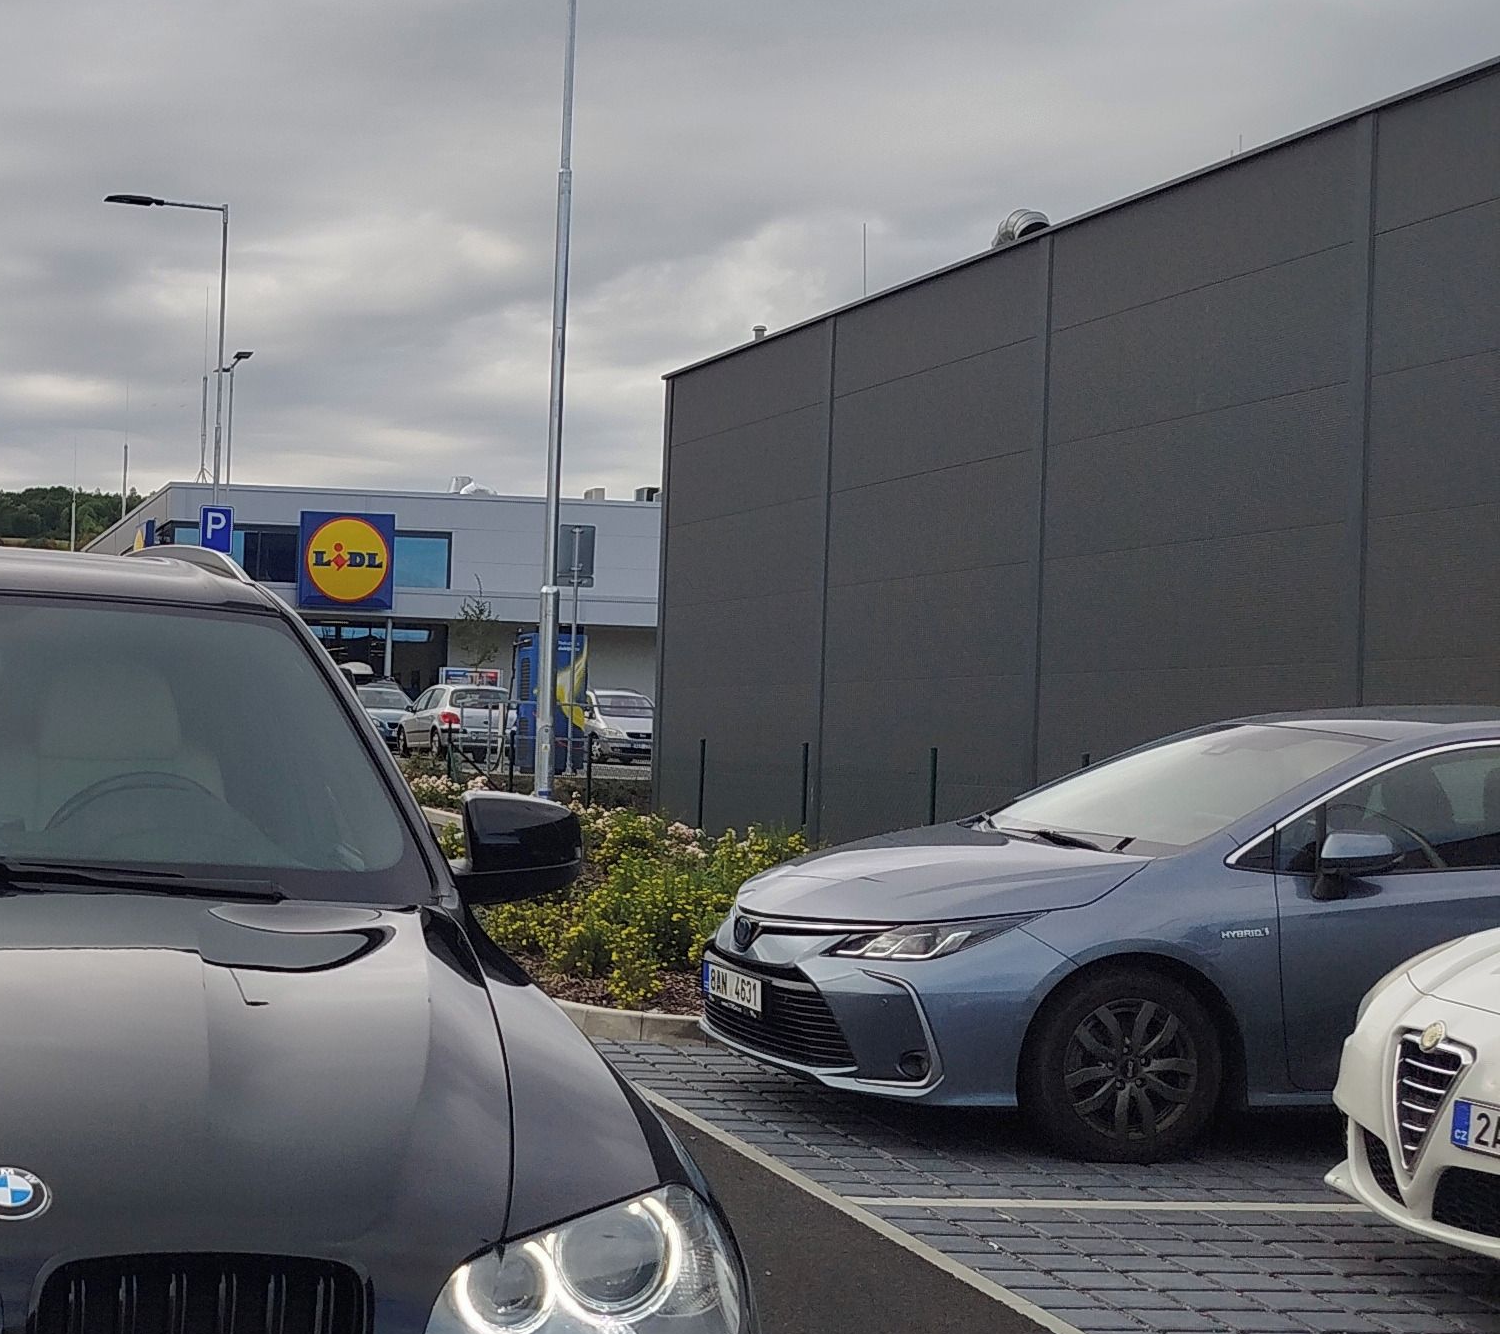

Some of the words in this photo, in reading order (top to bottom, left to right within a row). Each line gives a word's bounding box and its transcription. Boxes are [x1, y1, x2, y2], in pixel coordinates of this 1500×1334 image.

[206, 511, 226, 540] P
[734, 976, 757, 1007] 4631
[1453, 1129, 1468, 1141] CZ
